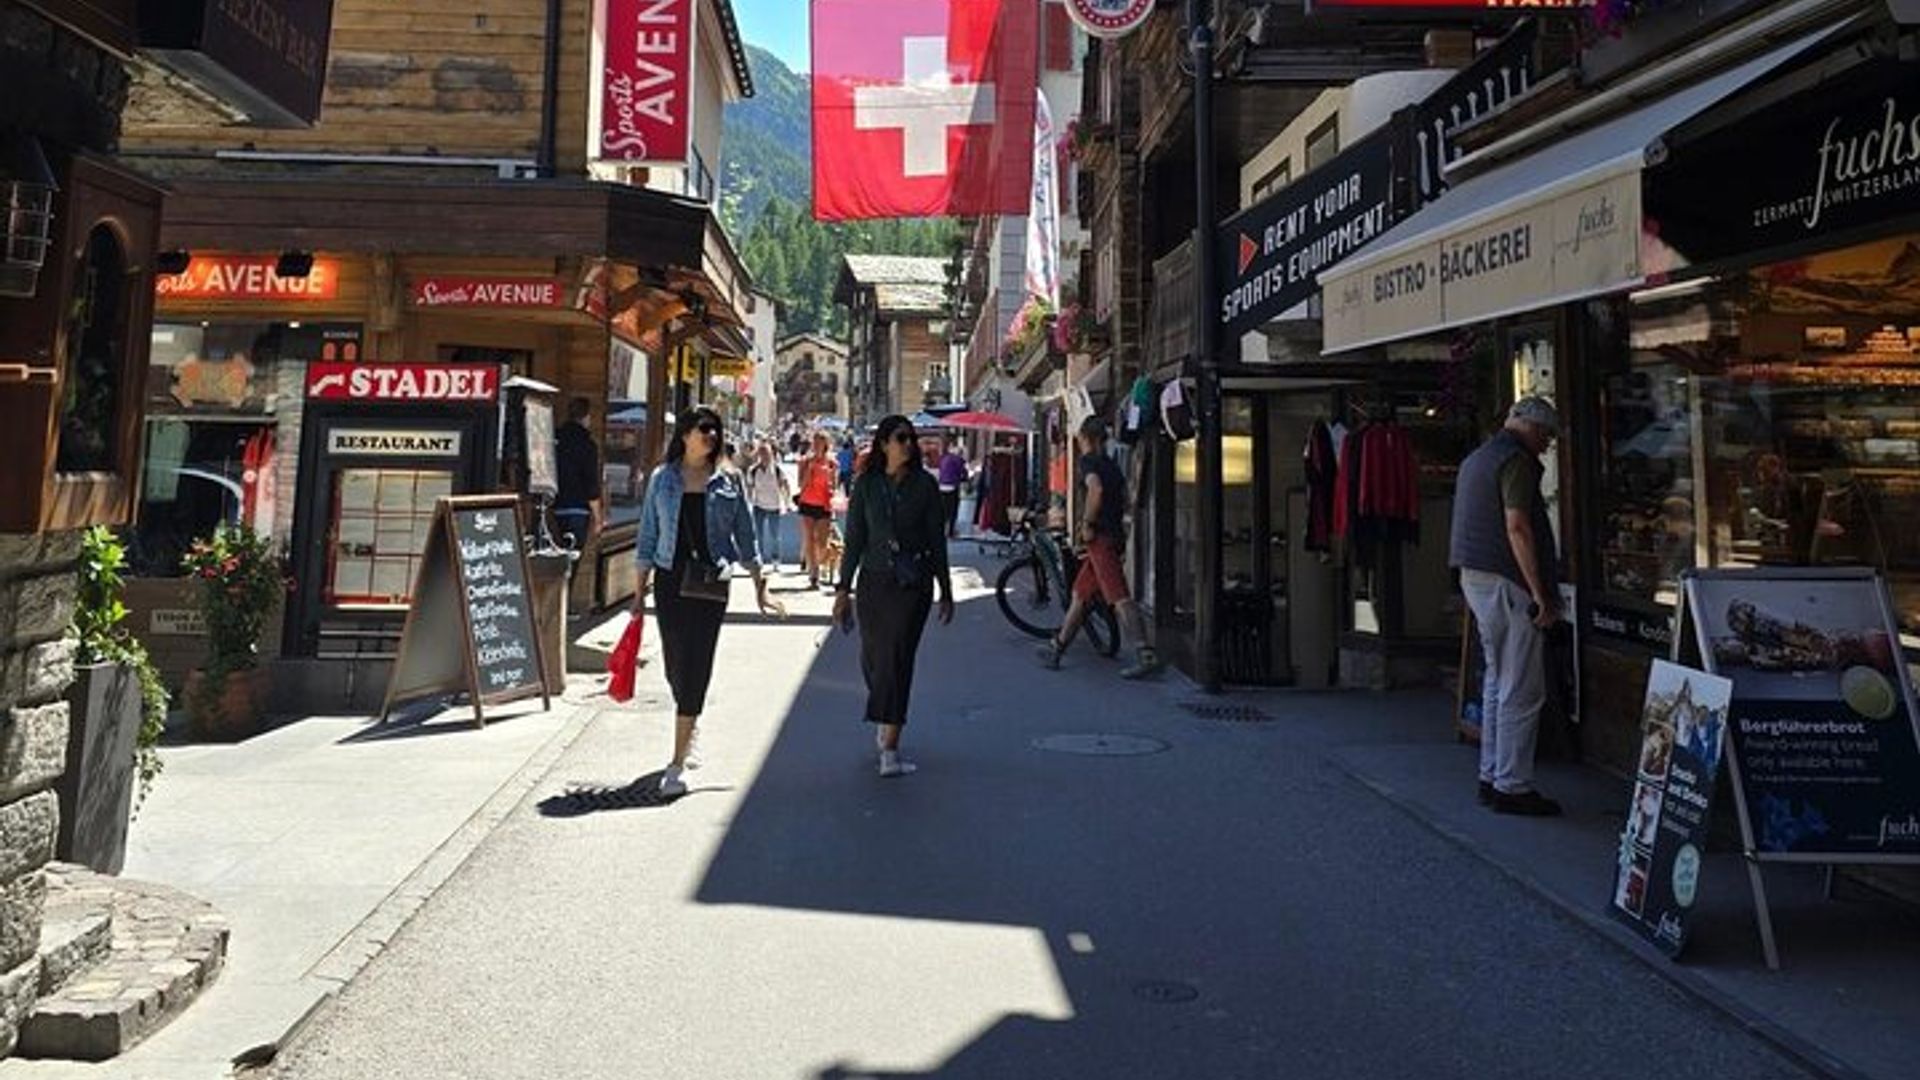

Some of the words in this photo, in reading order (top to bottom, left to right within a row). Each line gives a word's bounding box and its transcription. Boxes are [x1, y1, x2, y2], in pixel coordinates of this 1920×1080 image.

[1802, 97, 1920, 228] fuchs
[1263, 204, 1308, 256] RENT
[1313, 173, 1362, 224] YOUR
[1754, 195, 1814, 227] ZERMATT
[1221, 262, 1284, 323] SPORTS
[1288, 202, 1386, 284] EQUIPMENT
[1373, 263, 1427, 303] BISTRO
[1439, 223, 1531, 285] BÄCKEREI
[472, 283, 554, 304] AVENUE
[350, 367, 493, 399] STADEL
[335, 435, 453, 451] RESTAURANT
[1738, 717, 1868, 737] Bergführerbrot
